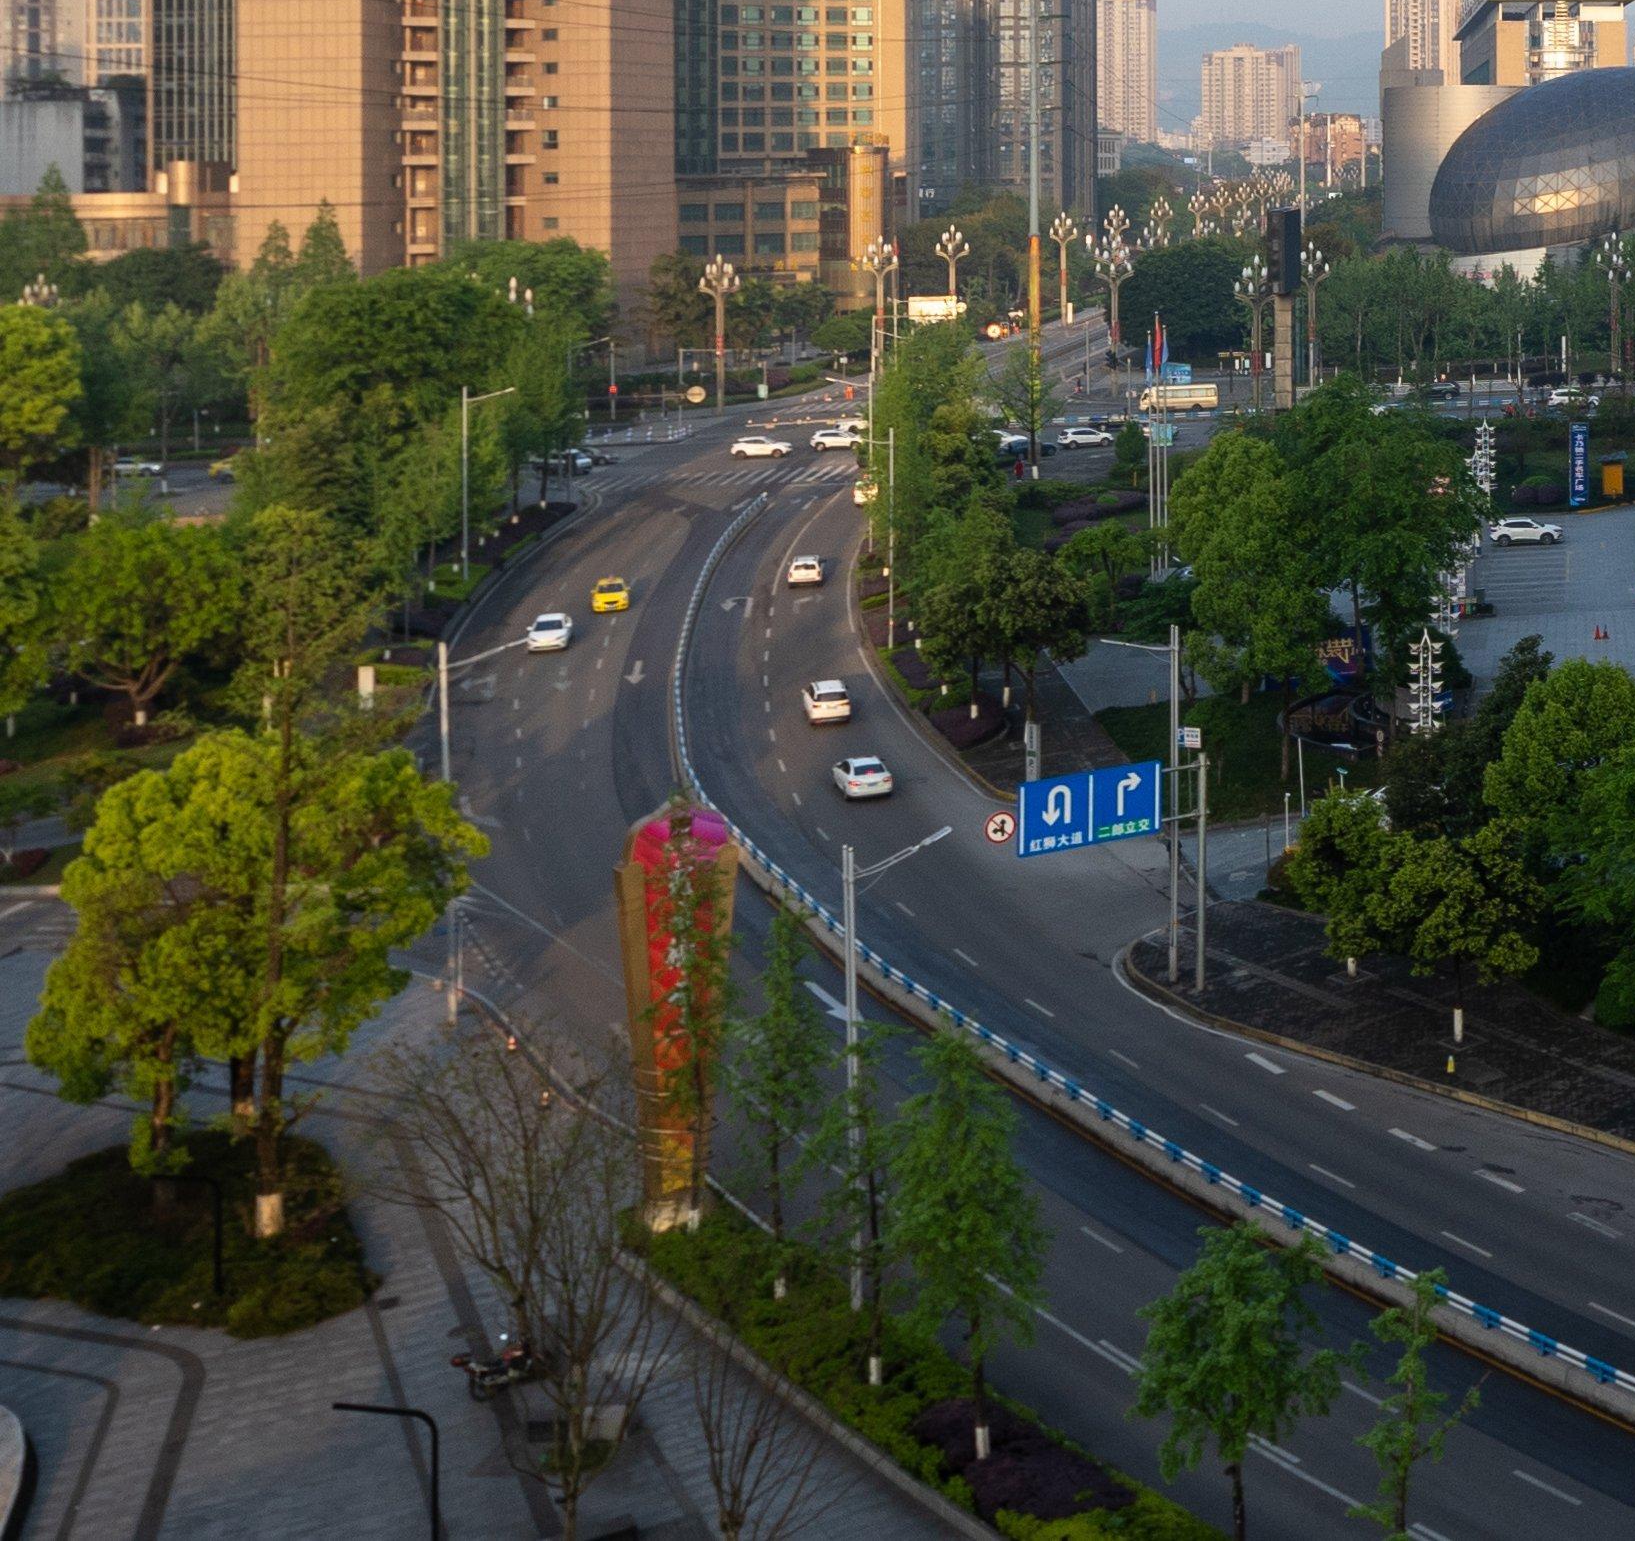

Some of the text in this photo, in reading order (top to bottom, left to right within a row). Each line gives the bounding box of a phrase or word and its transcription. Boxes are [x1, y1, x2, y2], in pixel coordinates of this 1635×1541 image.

[1098, 818, 1150, 838] 二郎立交
[1029, 831, 1083, 852] 红狮大道
